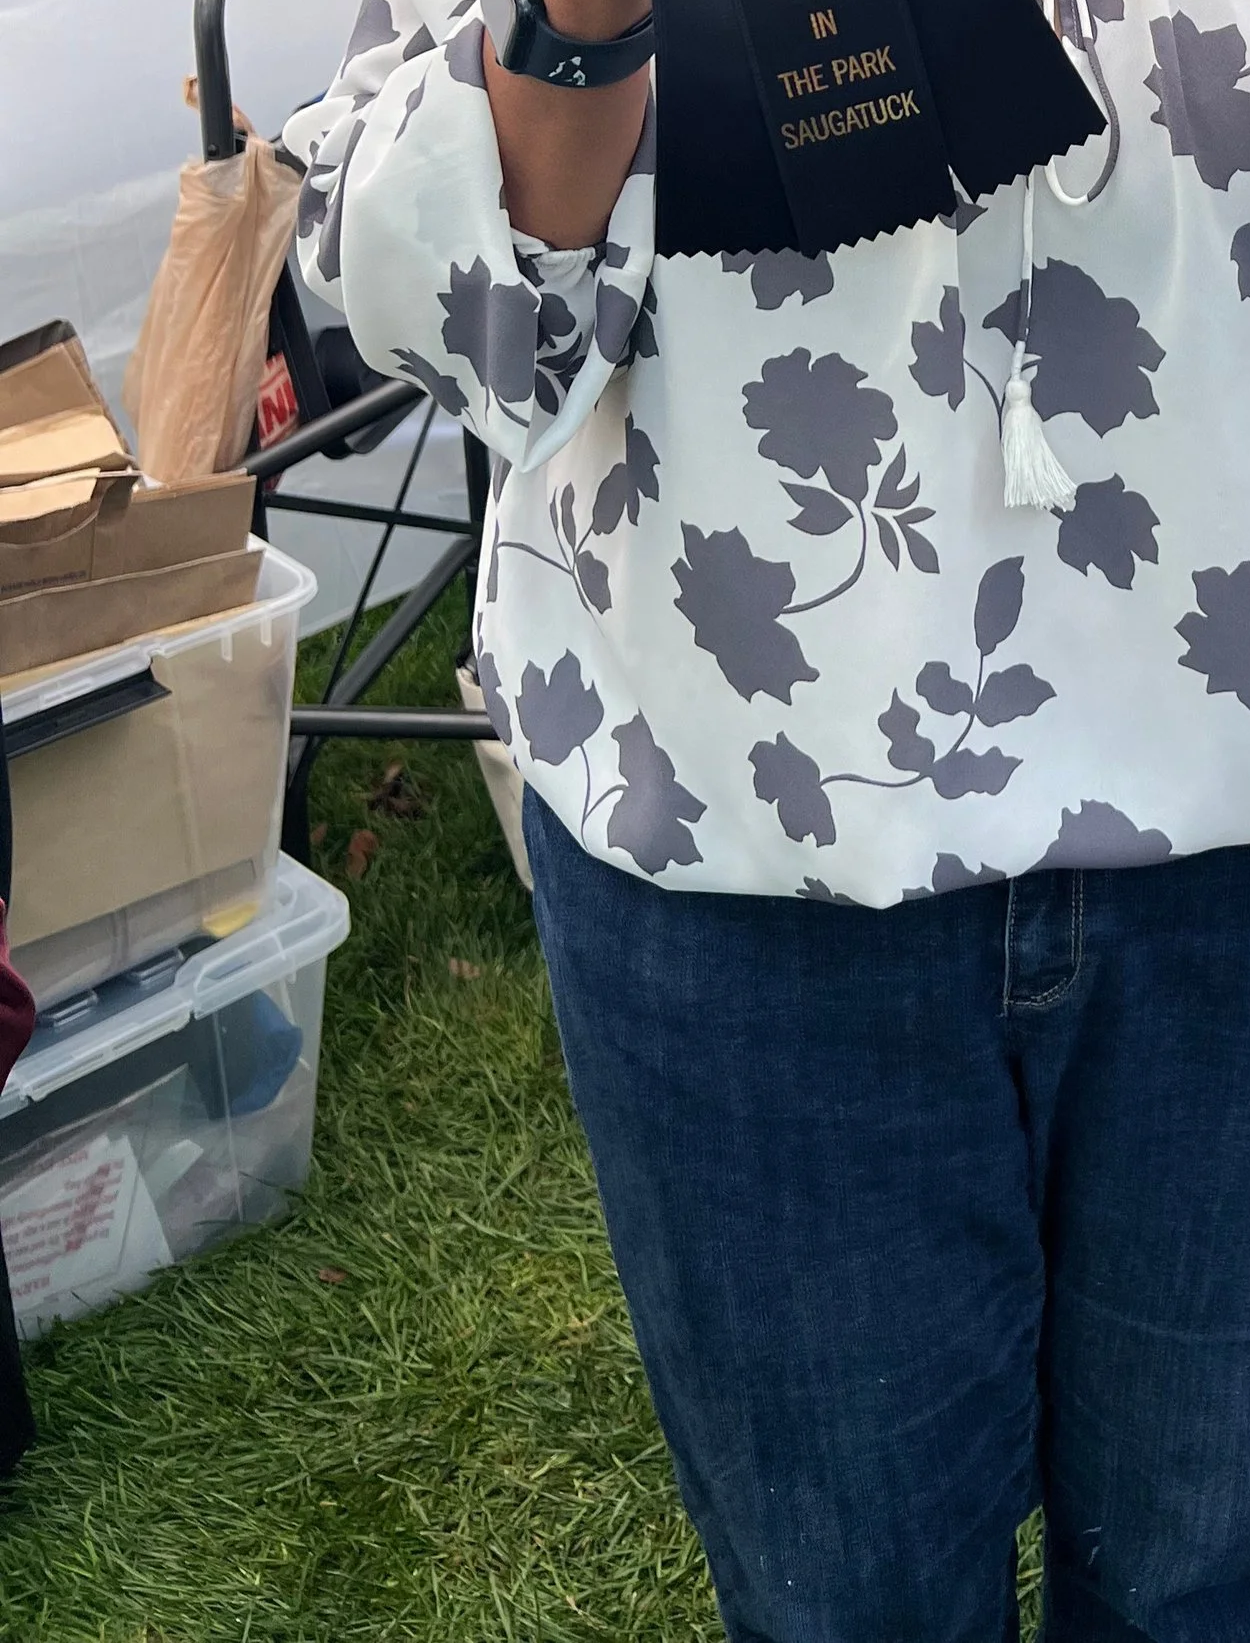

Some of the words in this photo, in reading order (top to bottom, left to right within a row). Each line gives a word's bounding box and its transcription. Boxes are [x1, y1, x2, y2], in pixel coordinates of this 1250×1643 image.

[809, 9, 838, 40] IN
[777, 64, 829, 99] THE
[832, 46, 896, 85] PARK
[781, 90, 920, 150] SAUGATUCK
